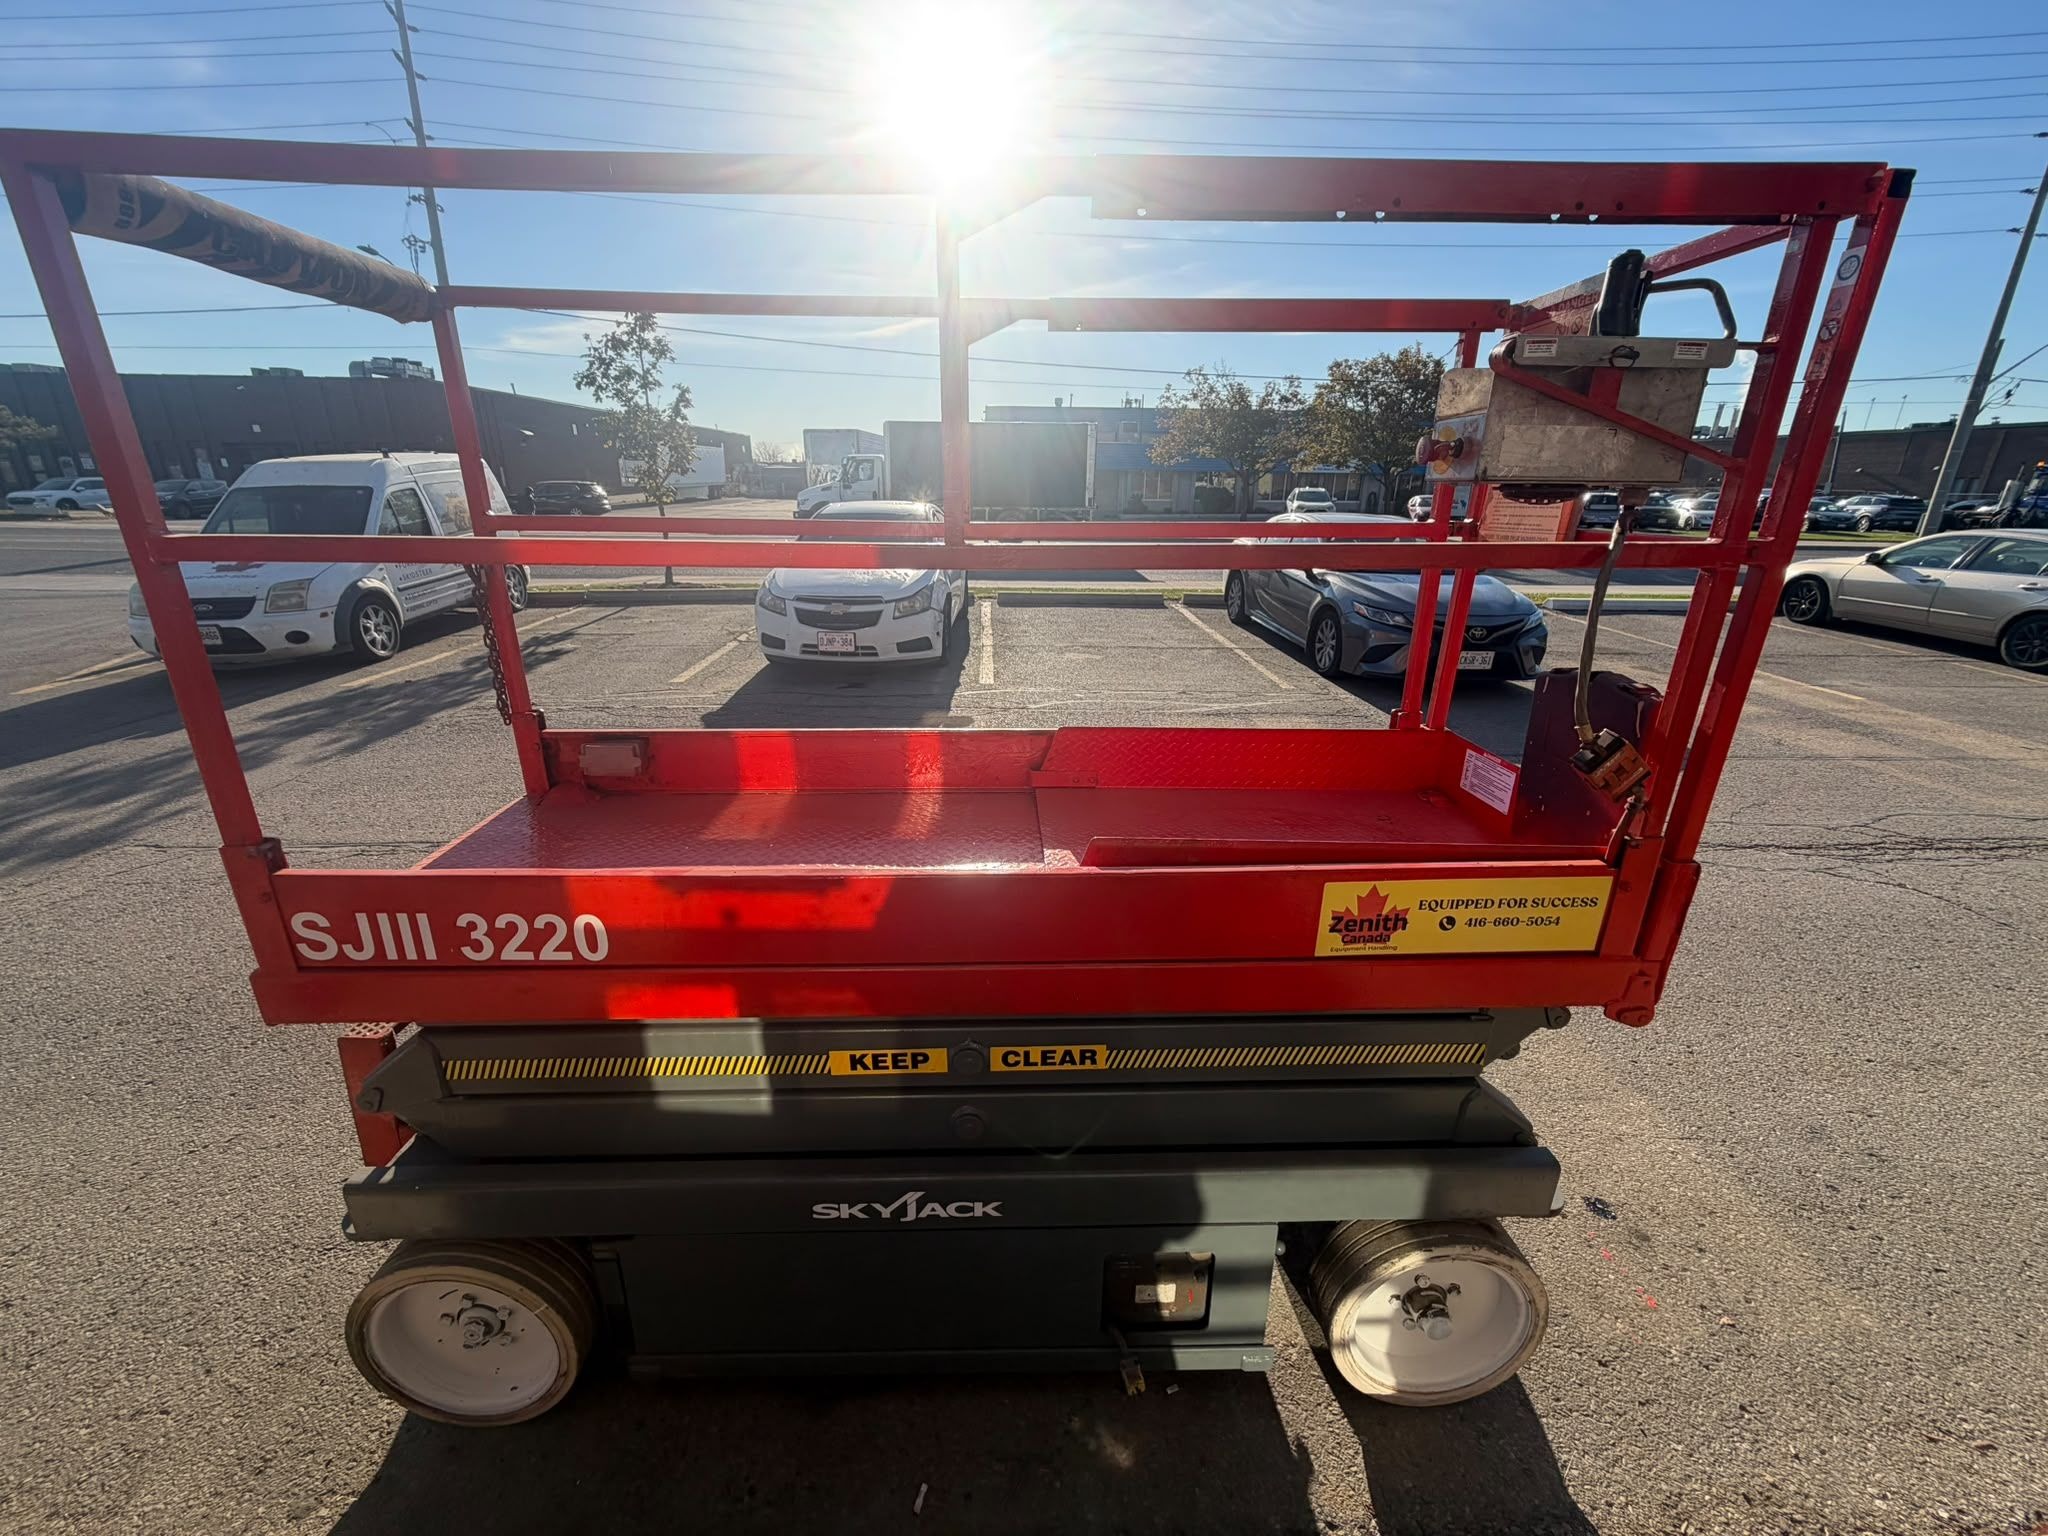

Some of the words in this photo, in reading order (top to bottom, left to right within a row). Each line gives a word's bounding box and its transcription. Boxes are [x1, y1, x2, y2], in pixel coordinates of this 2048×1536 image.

[1418, 897, 1495, 911] EQUIPPED
[1500, 897, 1528, 909] FOR
[1532, 895, 1599, 909] SUCCESS
[1328, 912, 1408, 933] Zenith
[1464, 916, 1561, 929] 416-660-5054
[455, 912, 609, 962] 3220
[1341, 932, 1392, 944] Canada
[849, 1051, 930, 1071] KEEP
[1001, 1049, 1098, 1068] CLEAR
[812, 1191, 1003, 1222] SKYJACK
